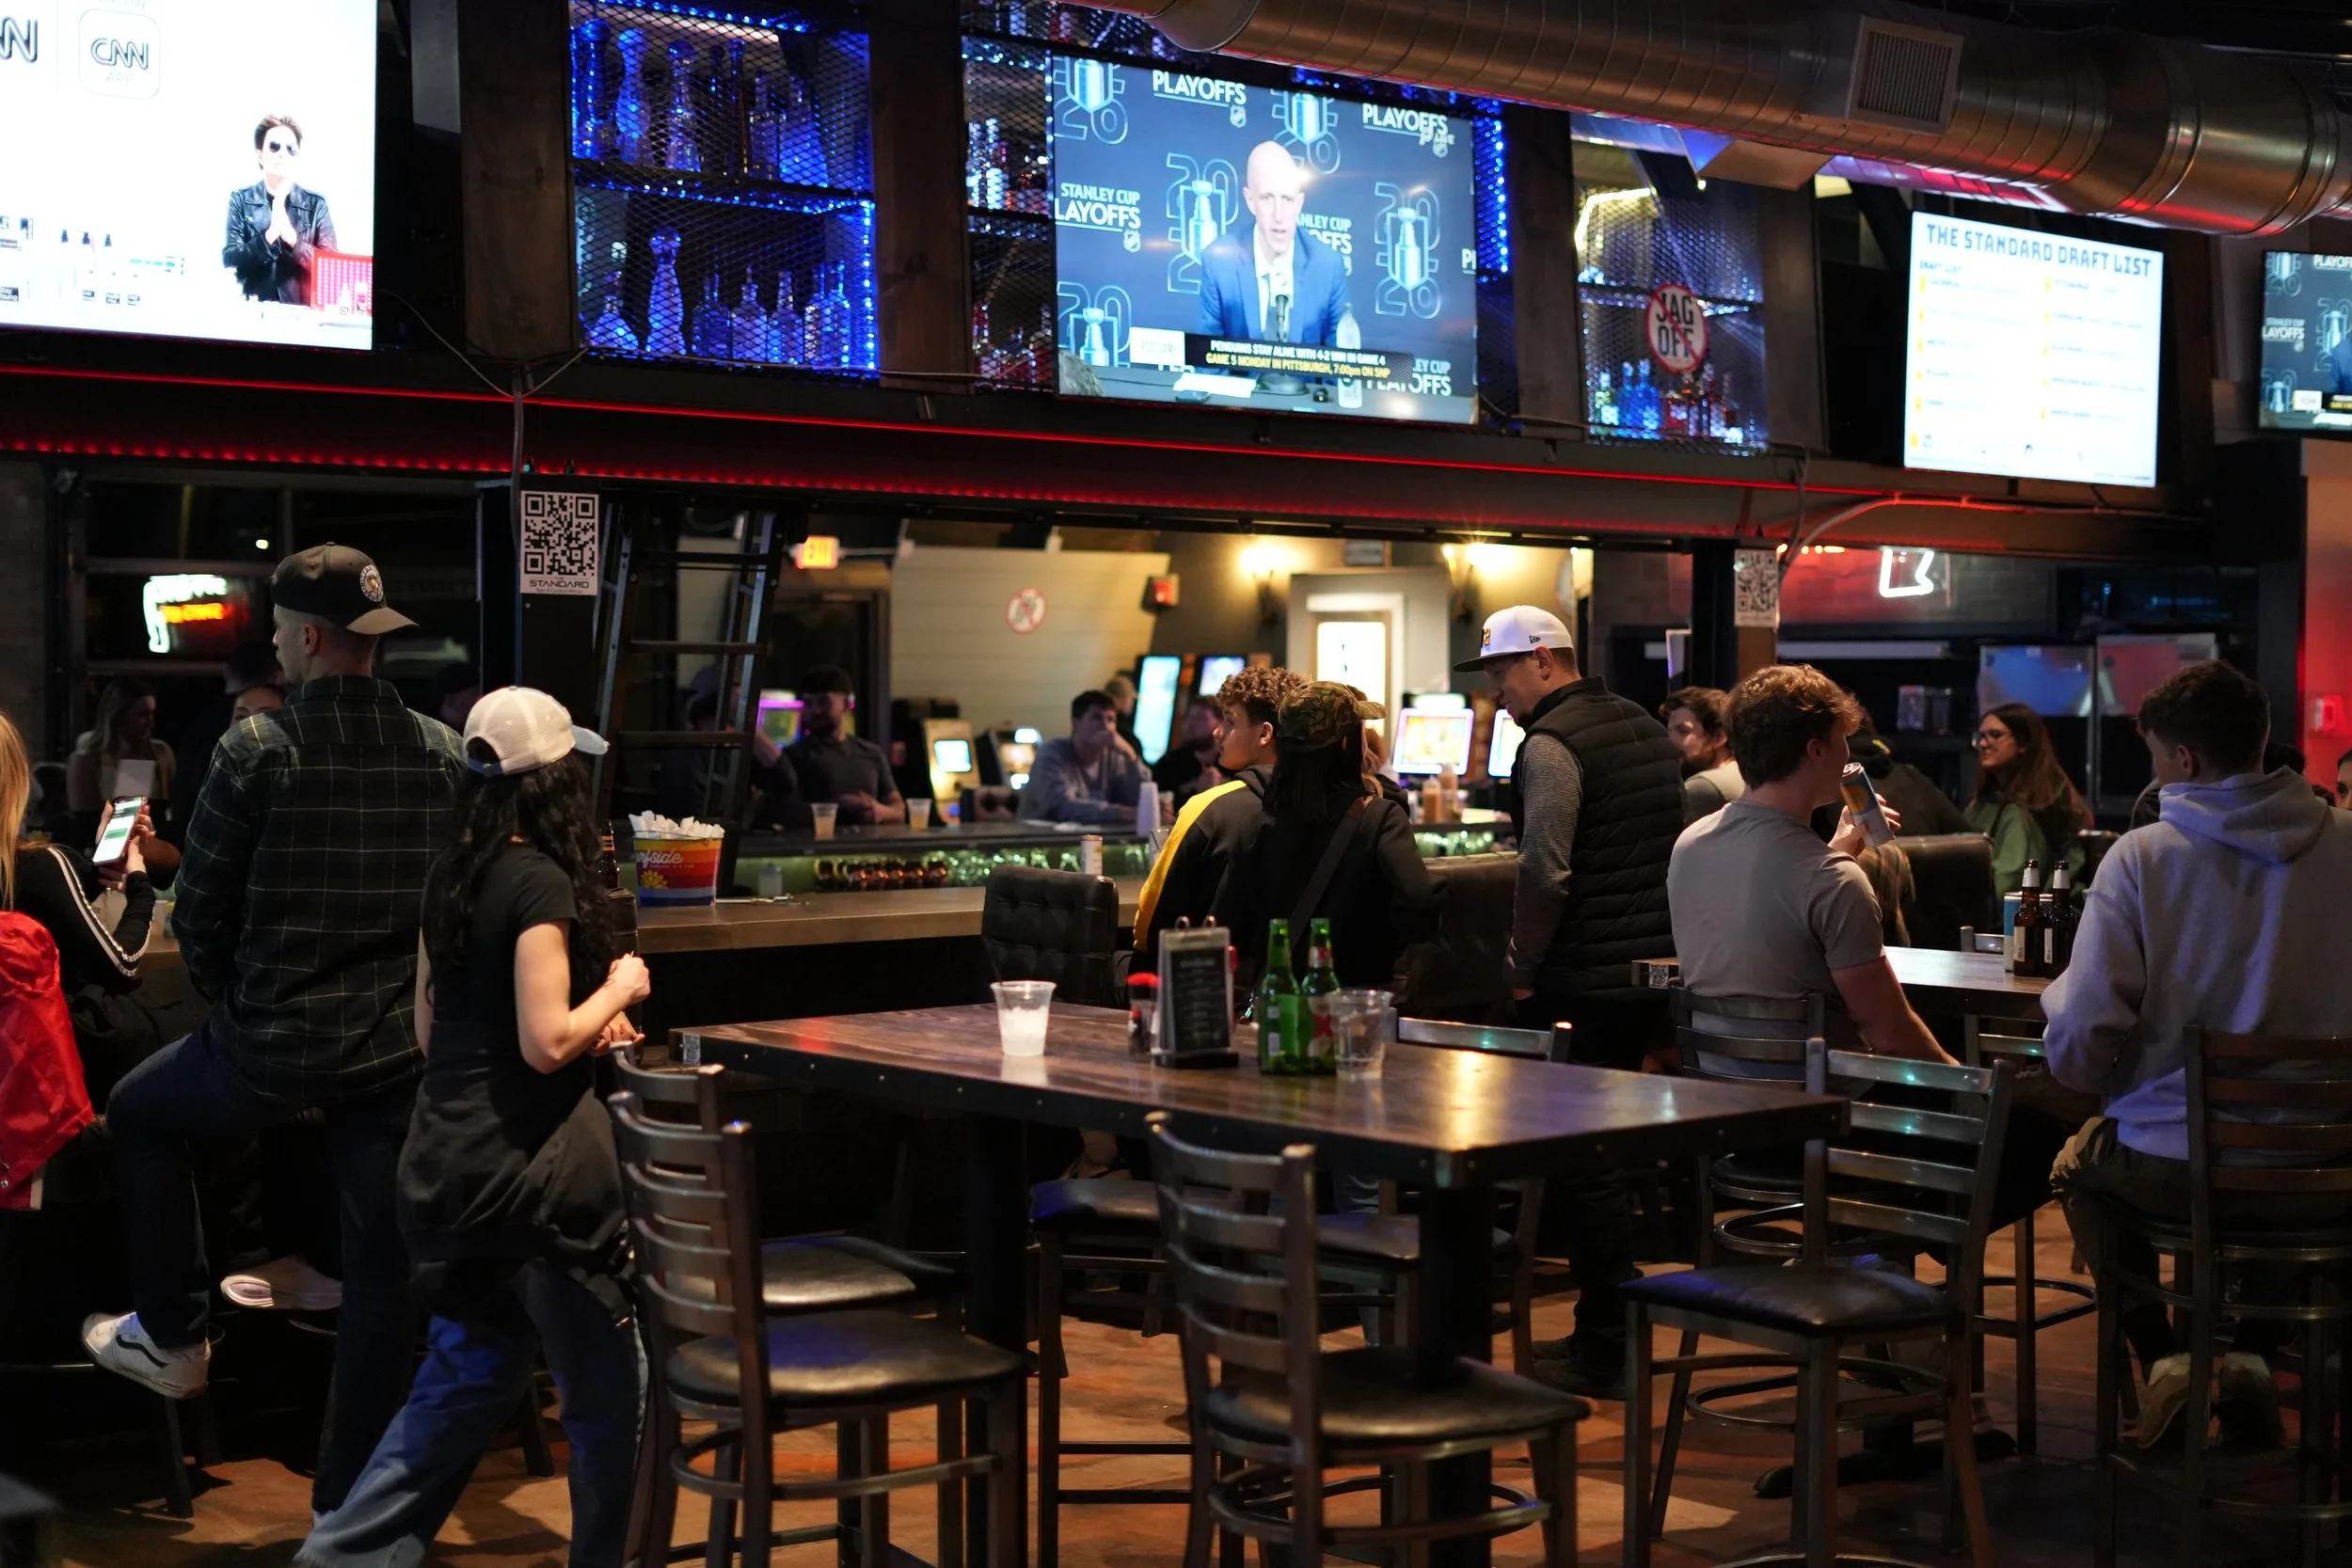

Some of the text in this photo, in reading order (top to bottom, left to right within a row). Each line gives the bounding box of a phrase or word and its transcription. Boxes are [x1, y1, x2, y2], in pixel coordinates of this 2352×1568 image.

[90, 37, 149, 70] CNN
[1152, 70, 1247, 105] PLAYOFFS
[1362, 103, 1450, 135] PLAYOFFS
[1060, 182, 1140, 206] STANLEY CUP
[1054, 198, 1141, 230] LAYOFFS
[1329, 216, 1352, 232] CUP
[1927, 223, 2152, 277] THE STANDARD DRAFT LIST
[1657, 293, 1693, 325] JAG
[1211, 340, 1252, 355] PENGUINS
[1252, 343, 1273, 356] STAY
[1273, 345, 1295, 358] ALIVE
[1295, 348, 1316, 360] WITH
[1316, 349, 1330, 362] 4-2
[1357, 353, 1379, 366] GAME
[1379, 355, 1386, 367] 4
[1658, 325, 1693, 357] OFF
[1205, 352, 1230, 366] GAME
[1237, 355, 1271, 369] MONDAY
[1272, 357, 1281, 370] IN
[1361, 365, 1374, 376] ON
[1430, 360, 1452, 375] CUP
[530, 579, 590, 589] STANDARD
